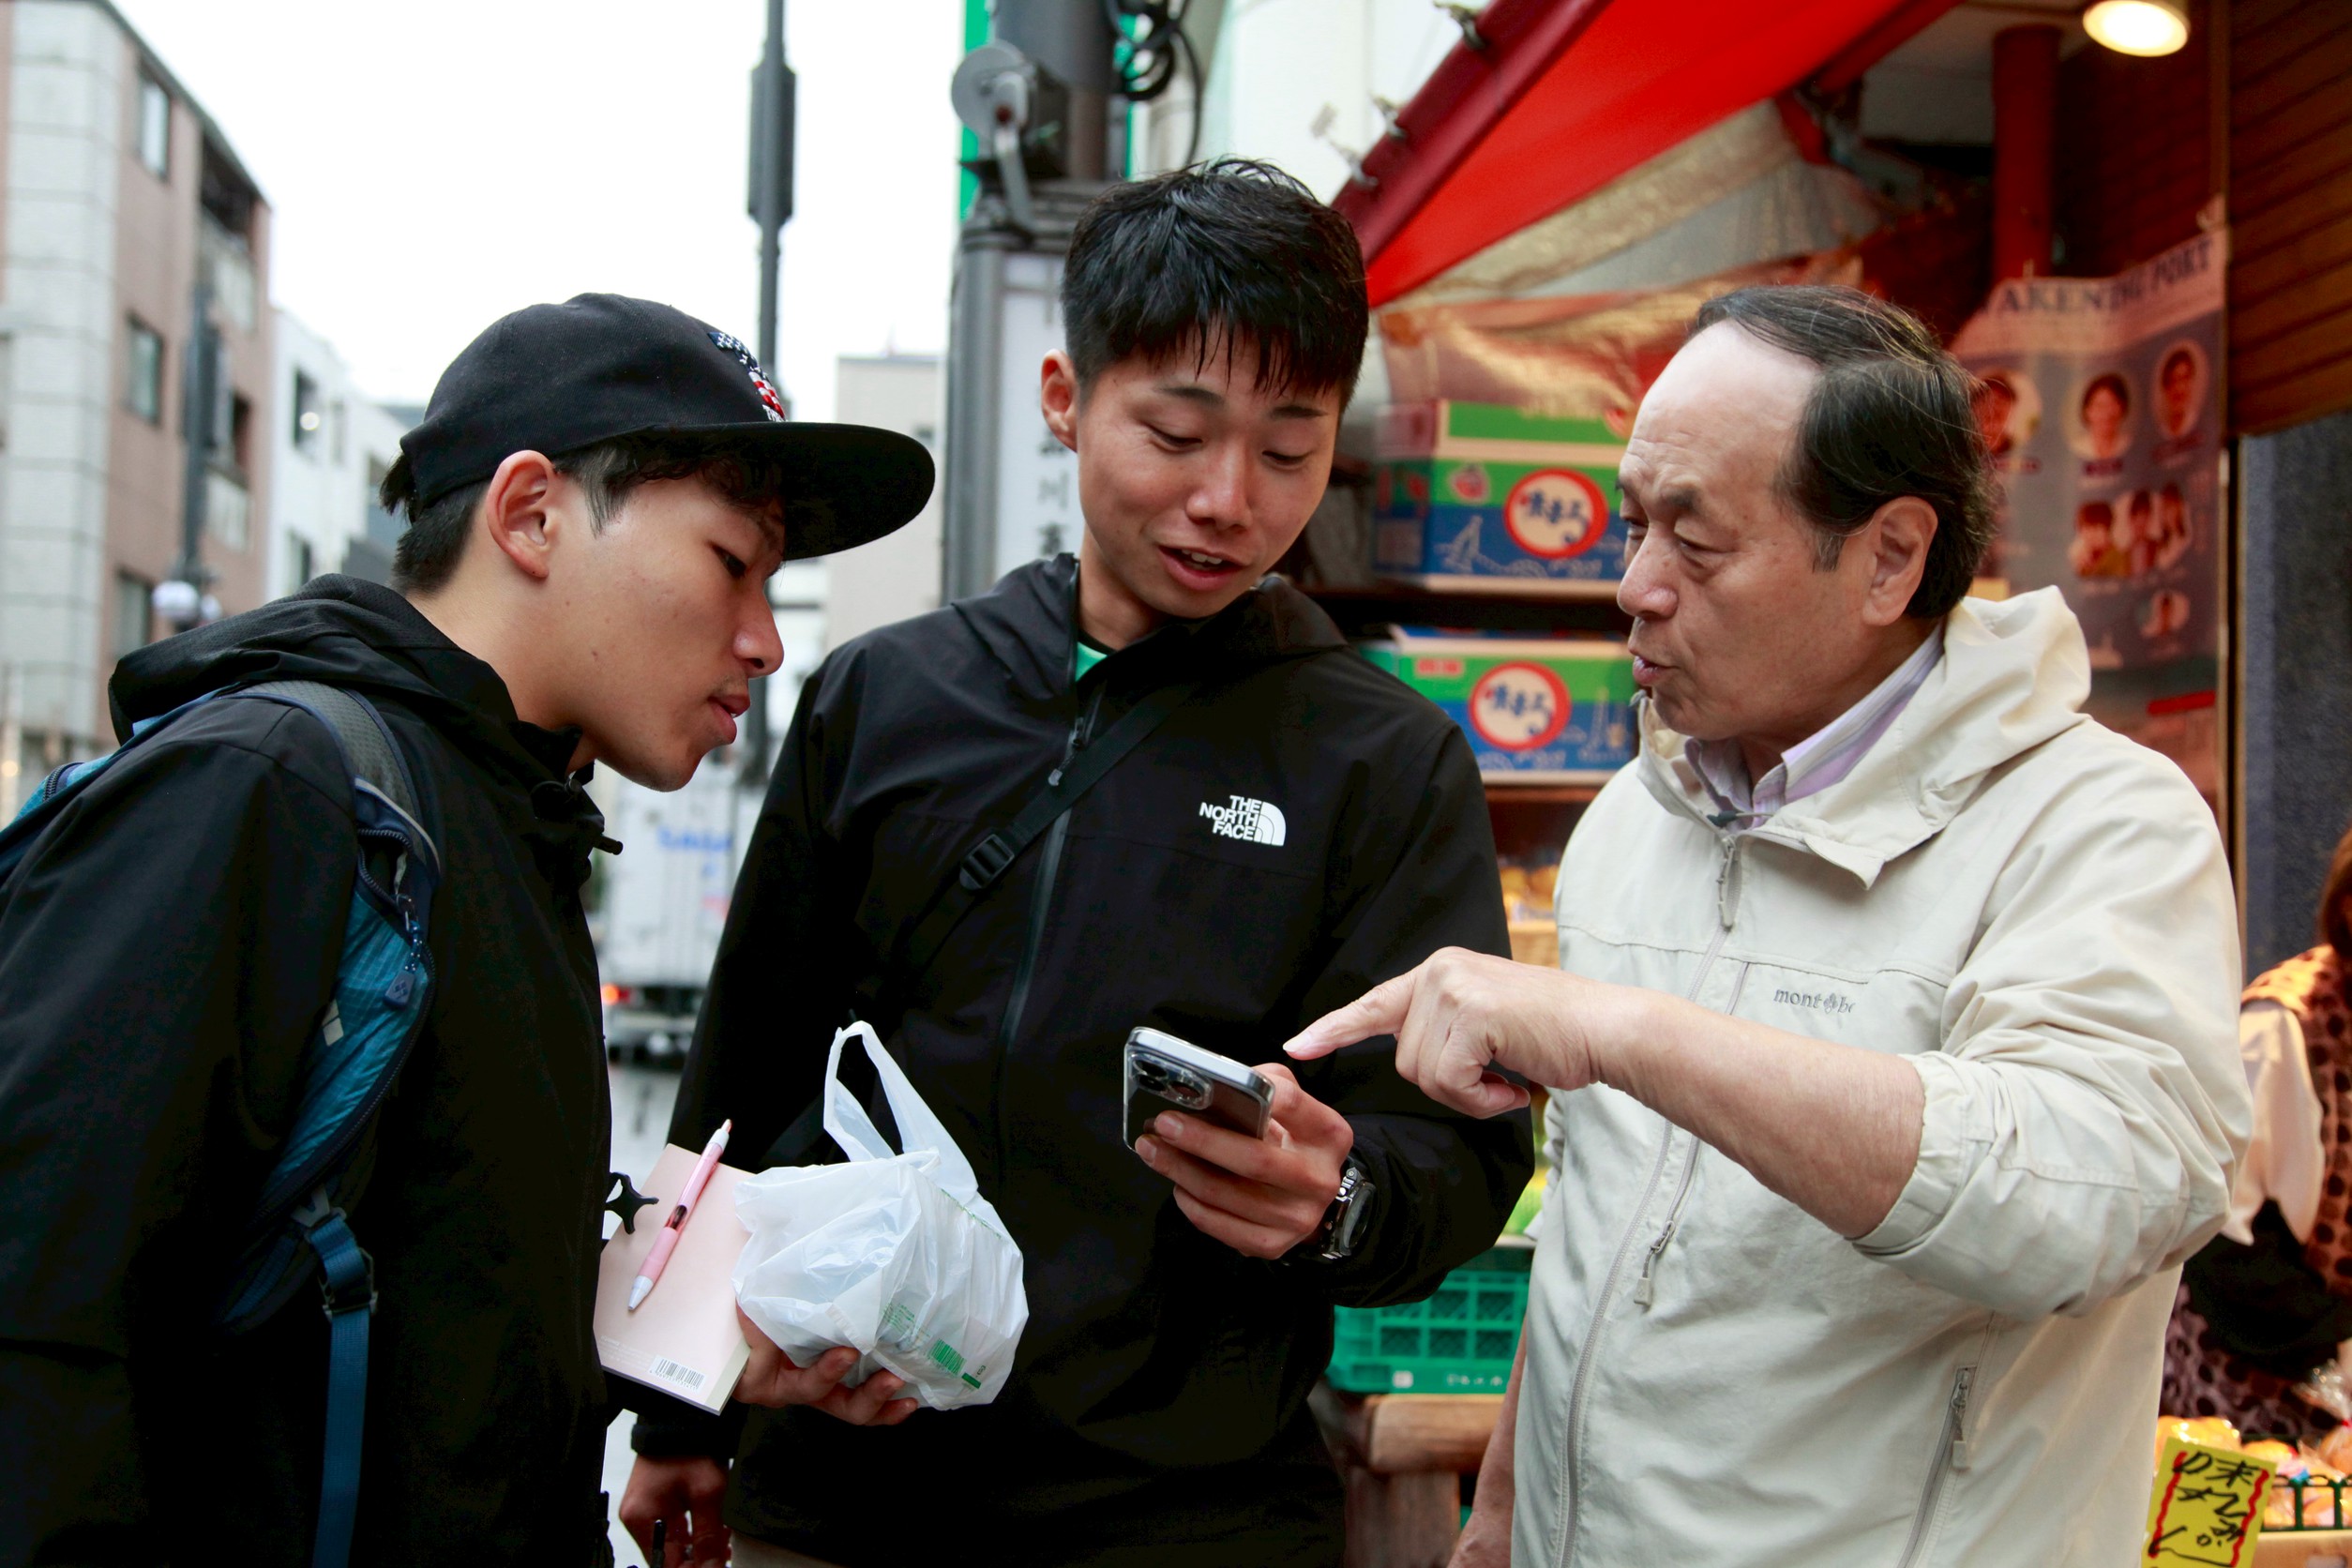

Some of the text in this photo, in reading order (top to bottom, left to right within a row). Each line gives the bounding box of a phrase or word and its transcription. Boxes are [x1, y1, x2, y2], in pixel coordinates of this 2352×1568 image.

[1229, 794, 1261, 814] THE
[1199, 802, 1259, 827] NORTH
[1213, 821, 1254, 841] FACE
